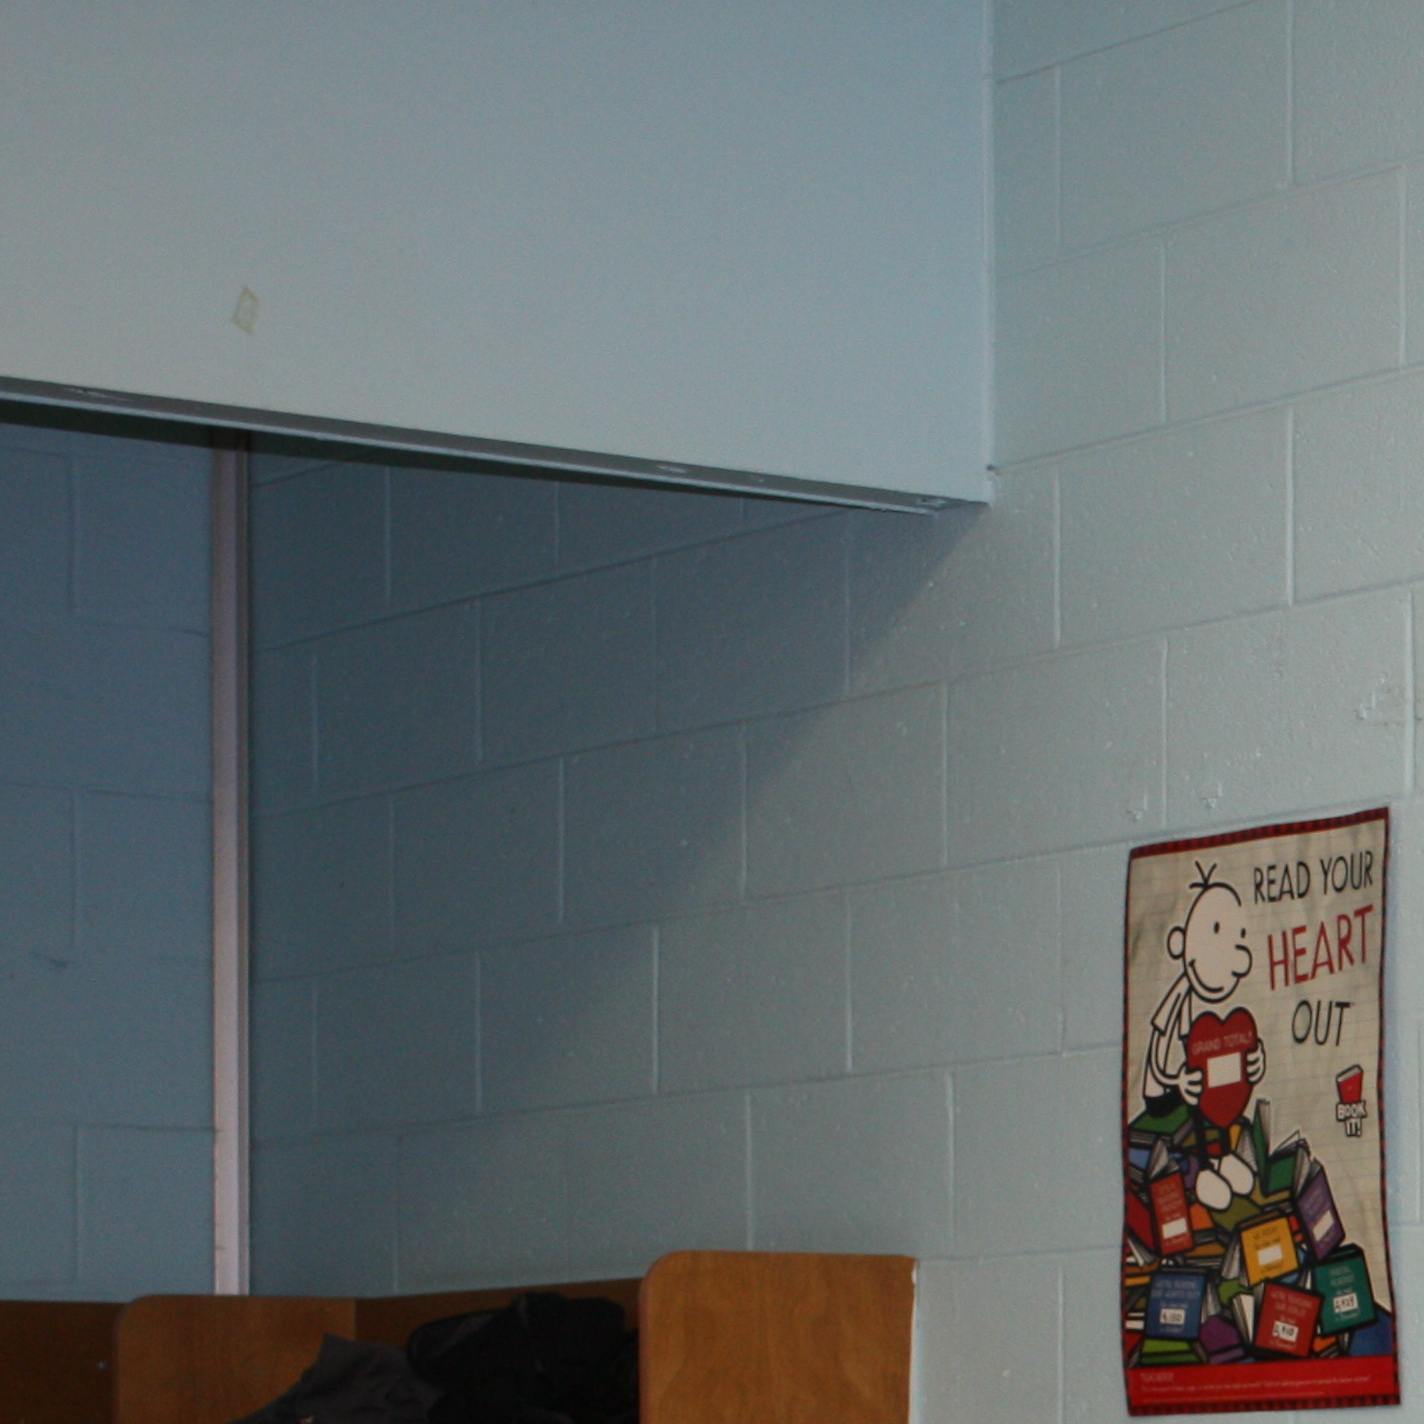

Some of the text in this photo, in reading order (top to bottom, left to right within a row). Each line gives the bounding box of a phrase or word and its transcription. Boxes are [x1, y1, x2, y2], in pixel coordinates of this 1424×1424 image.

[1254, 851, 1374, 904] READ YOUR
[1268, 905, 1373, 991] HEART
[1292, 1000, 1354, 1046] OUT
